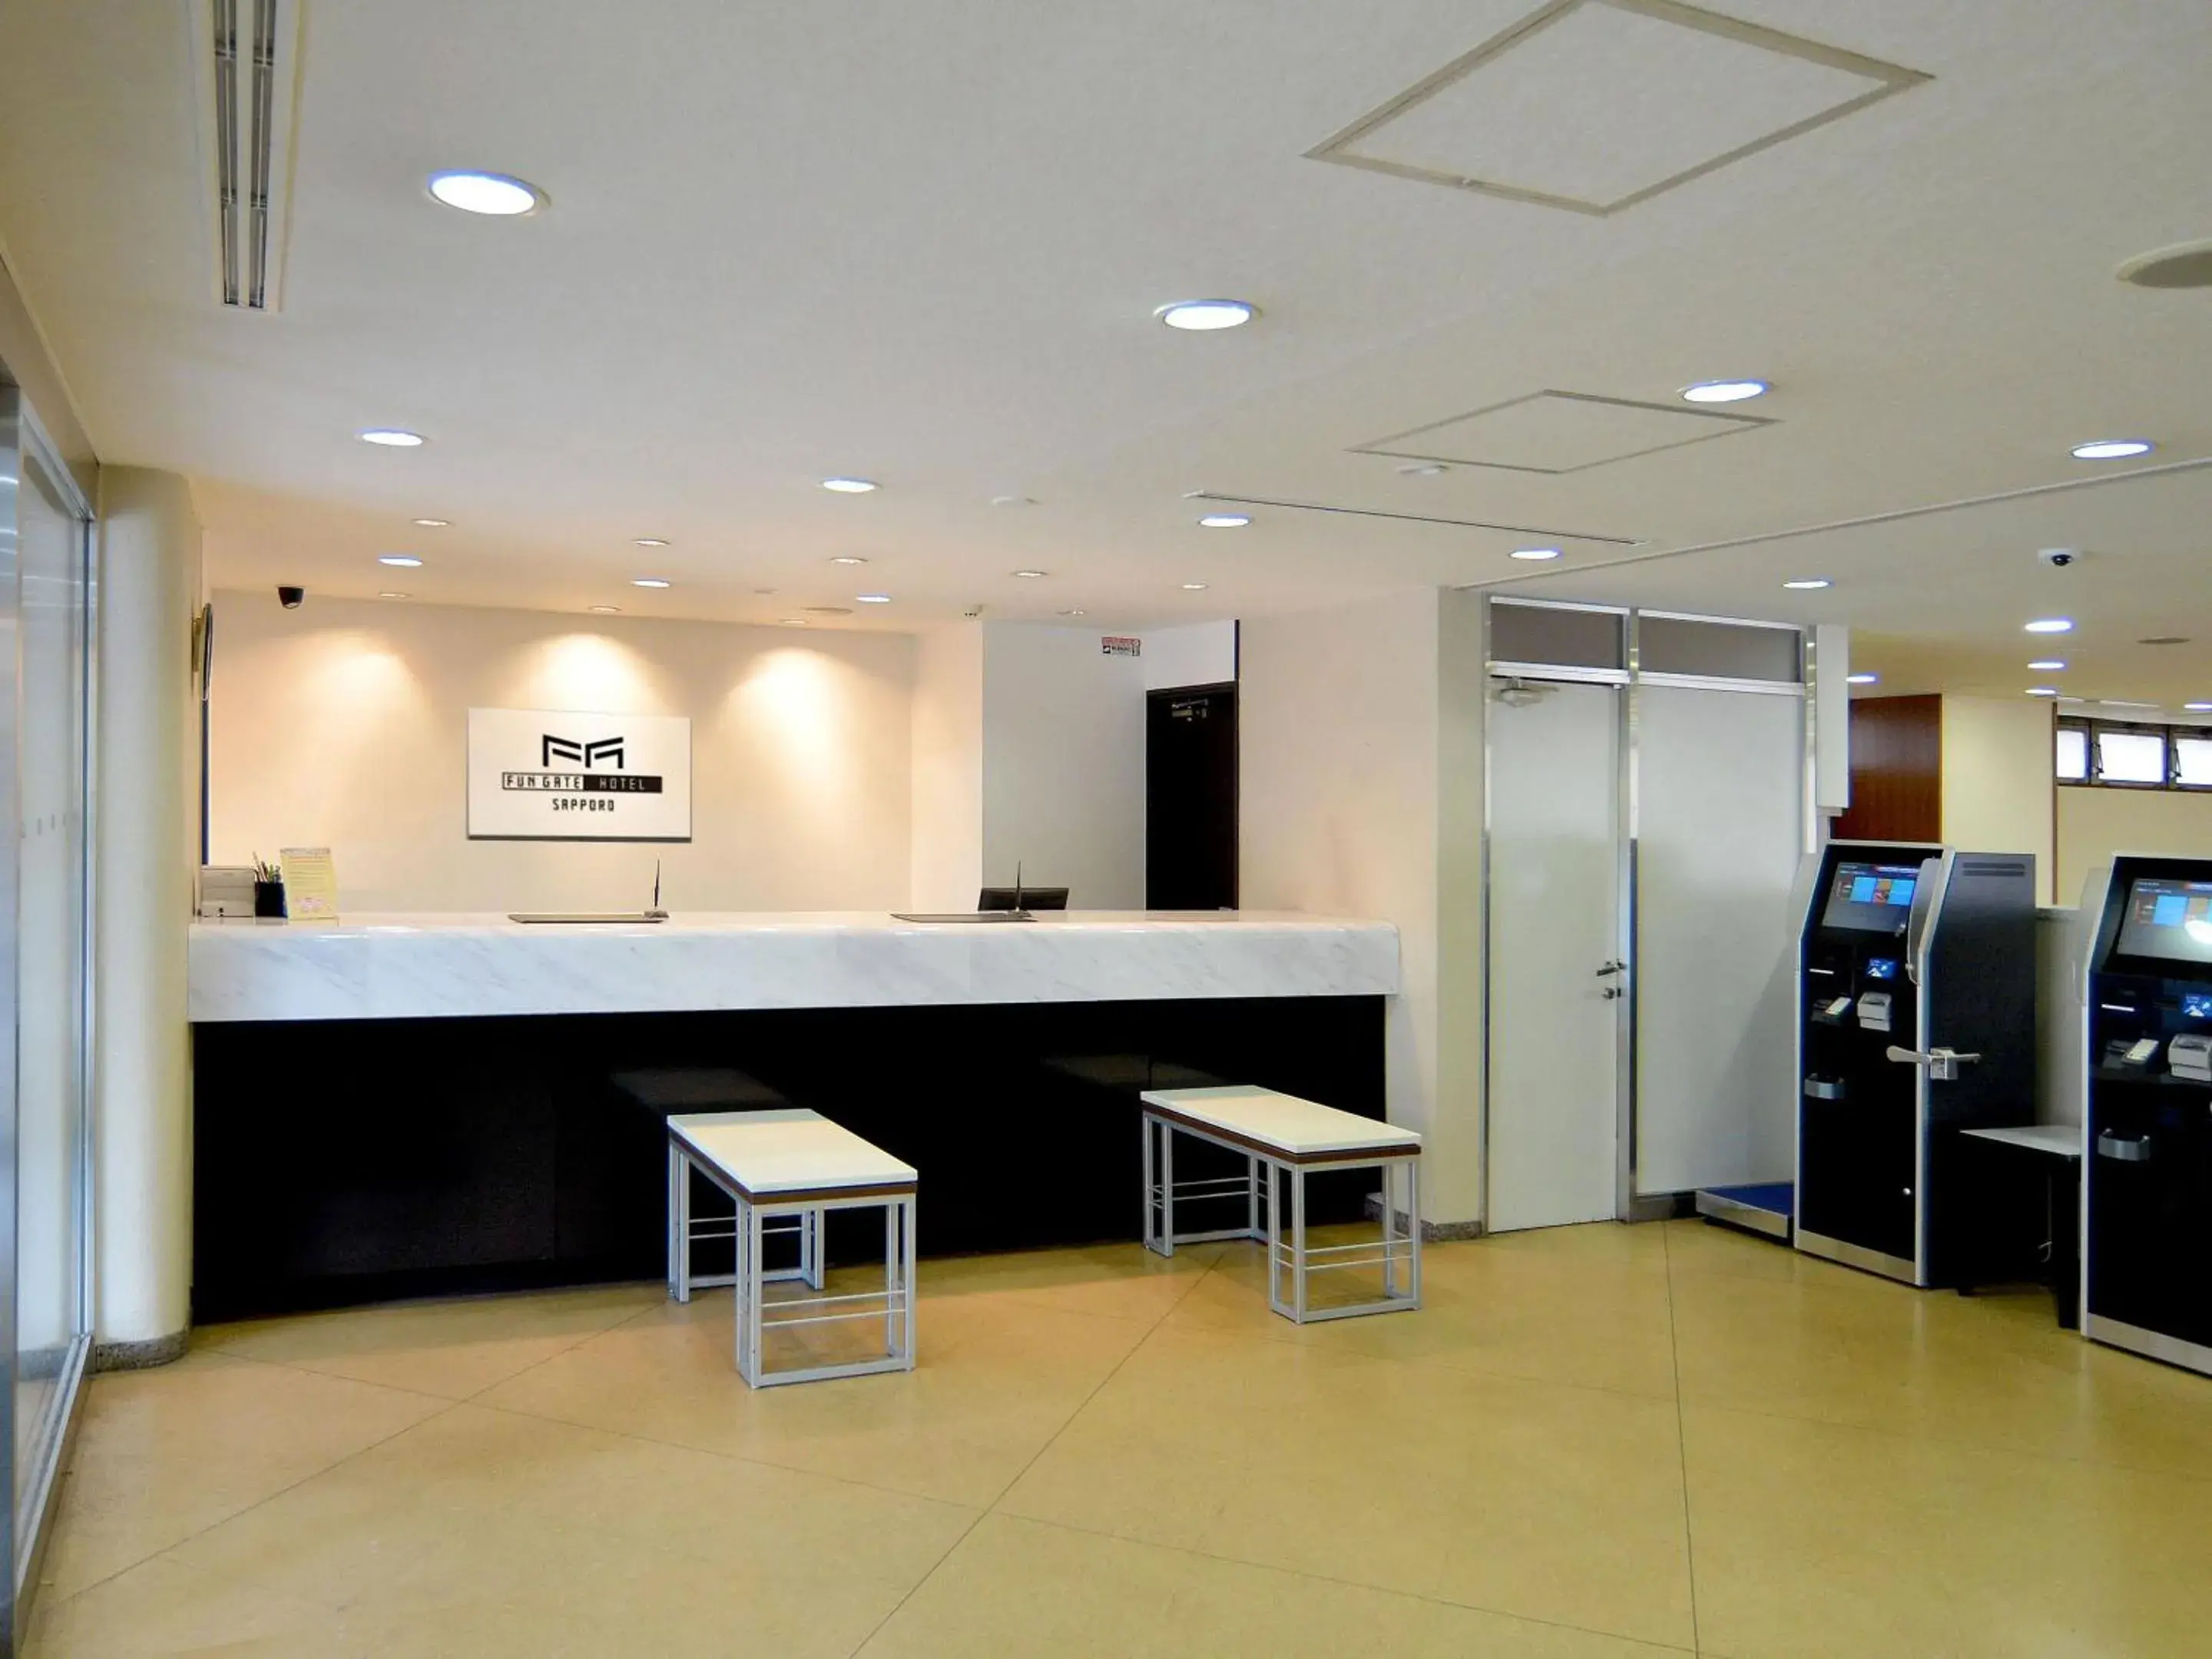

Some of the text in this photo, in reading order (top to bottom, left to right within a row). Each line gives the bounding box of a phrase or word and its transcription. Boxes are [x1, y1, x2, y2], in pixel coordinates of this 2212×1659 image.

[506, 774, 645, 790] FUN GATE HOTEL
[552, 798, 614, 811] SAPPORO
